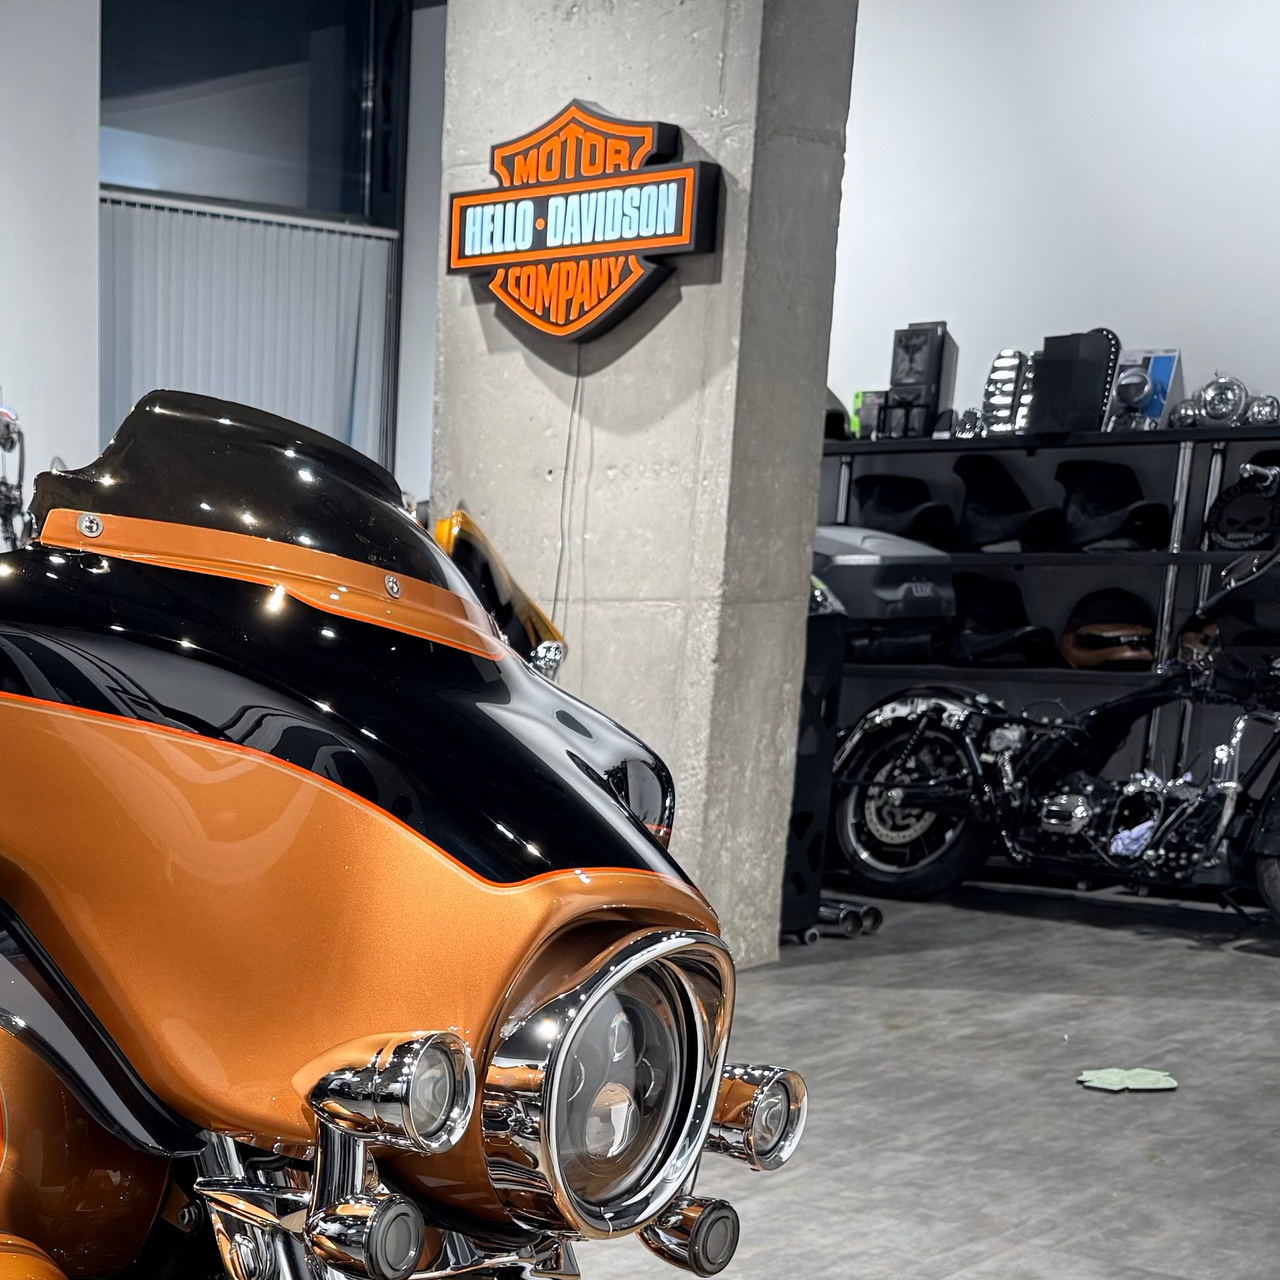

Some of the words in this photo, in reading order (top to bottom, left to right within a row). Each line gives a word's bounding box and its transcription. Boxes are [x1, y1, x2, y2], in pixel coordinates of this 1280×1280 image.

[513, 122, 631, 186] MOTOR
[464, 199, 535, 256] HELLO
[546, 182, 678, 247] DAVIDSON
[507, 256, 626, 325] COMPANY
